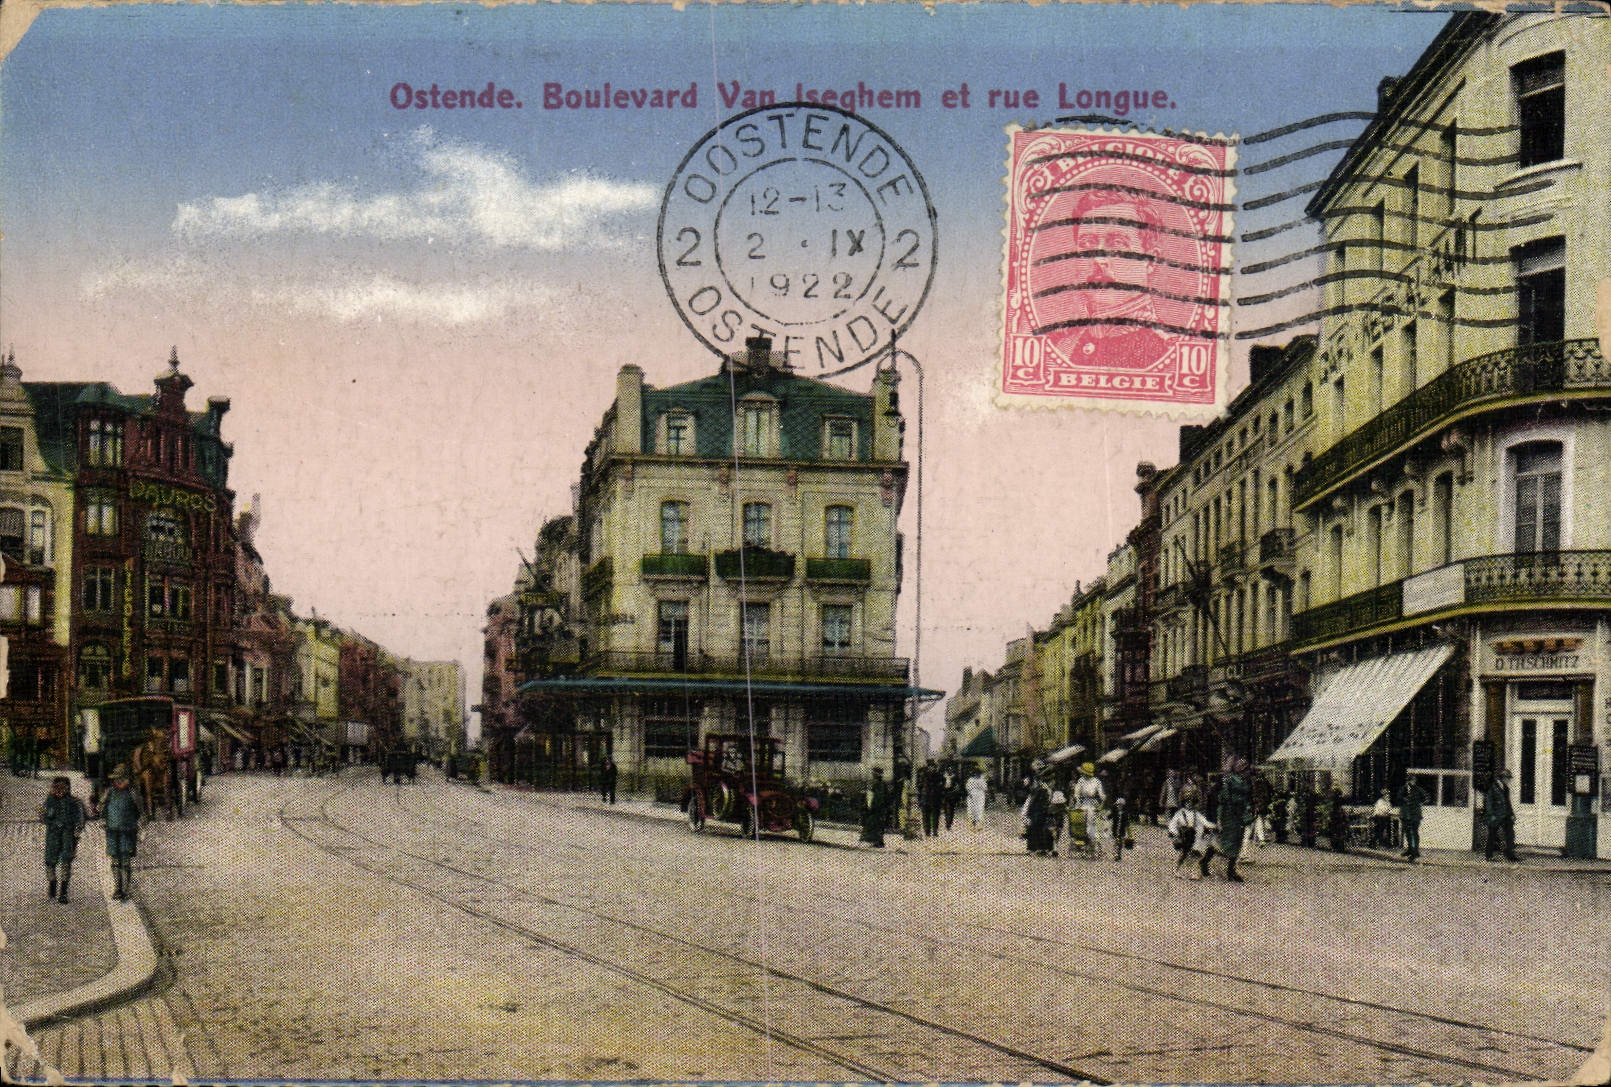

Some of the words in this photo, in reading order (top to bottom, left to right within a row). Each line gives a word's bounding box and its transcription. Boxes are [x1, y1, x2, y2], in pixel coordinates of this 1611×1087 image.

[684, 113, 915, 206] OOSTENDE
[1059, 141, 1182, 181] BELGIQUE
[676, 226, 702, 267] 2
[747, 232, 766, 260] 2
[891, 229, 920, 271] 2
[750, 272, 853, 299] 1922
[688, 286, 909, 370] OSTENDE
[1013, 338, 1039, 367] 10
[1181, 345, 1206, 374] 10
[1058, 368, 1160, 390] BELGIE
